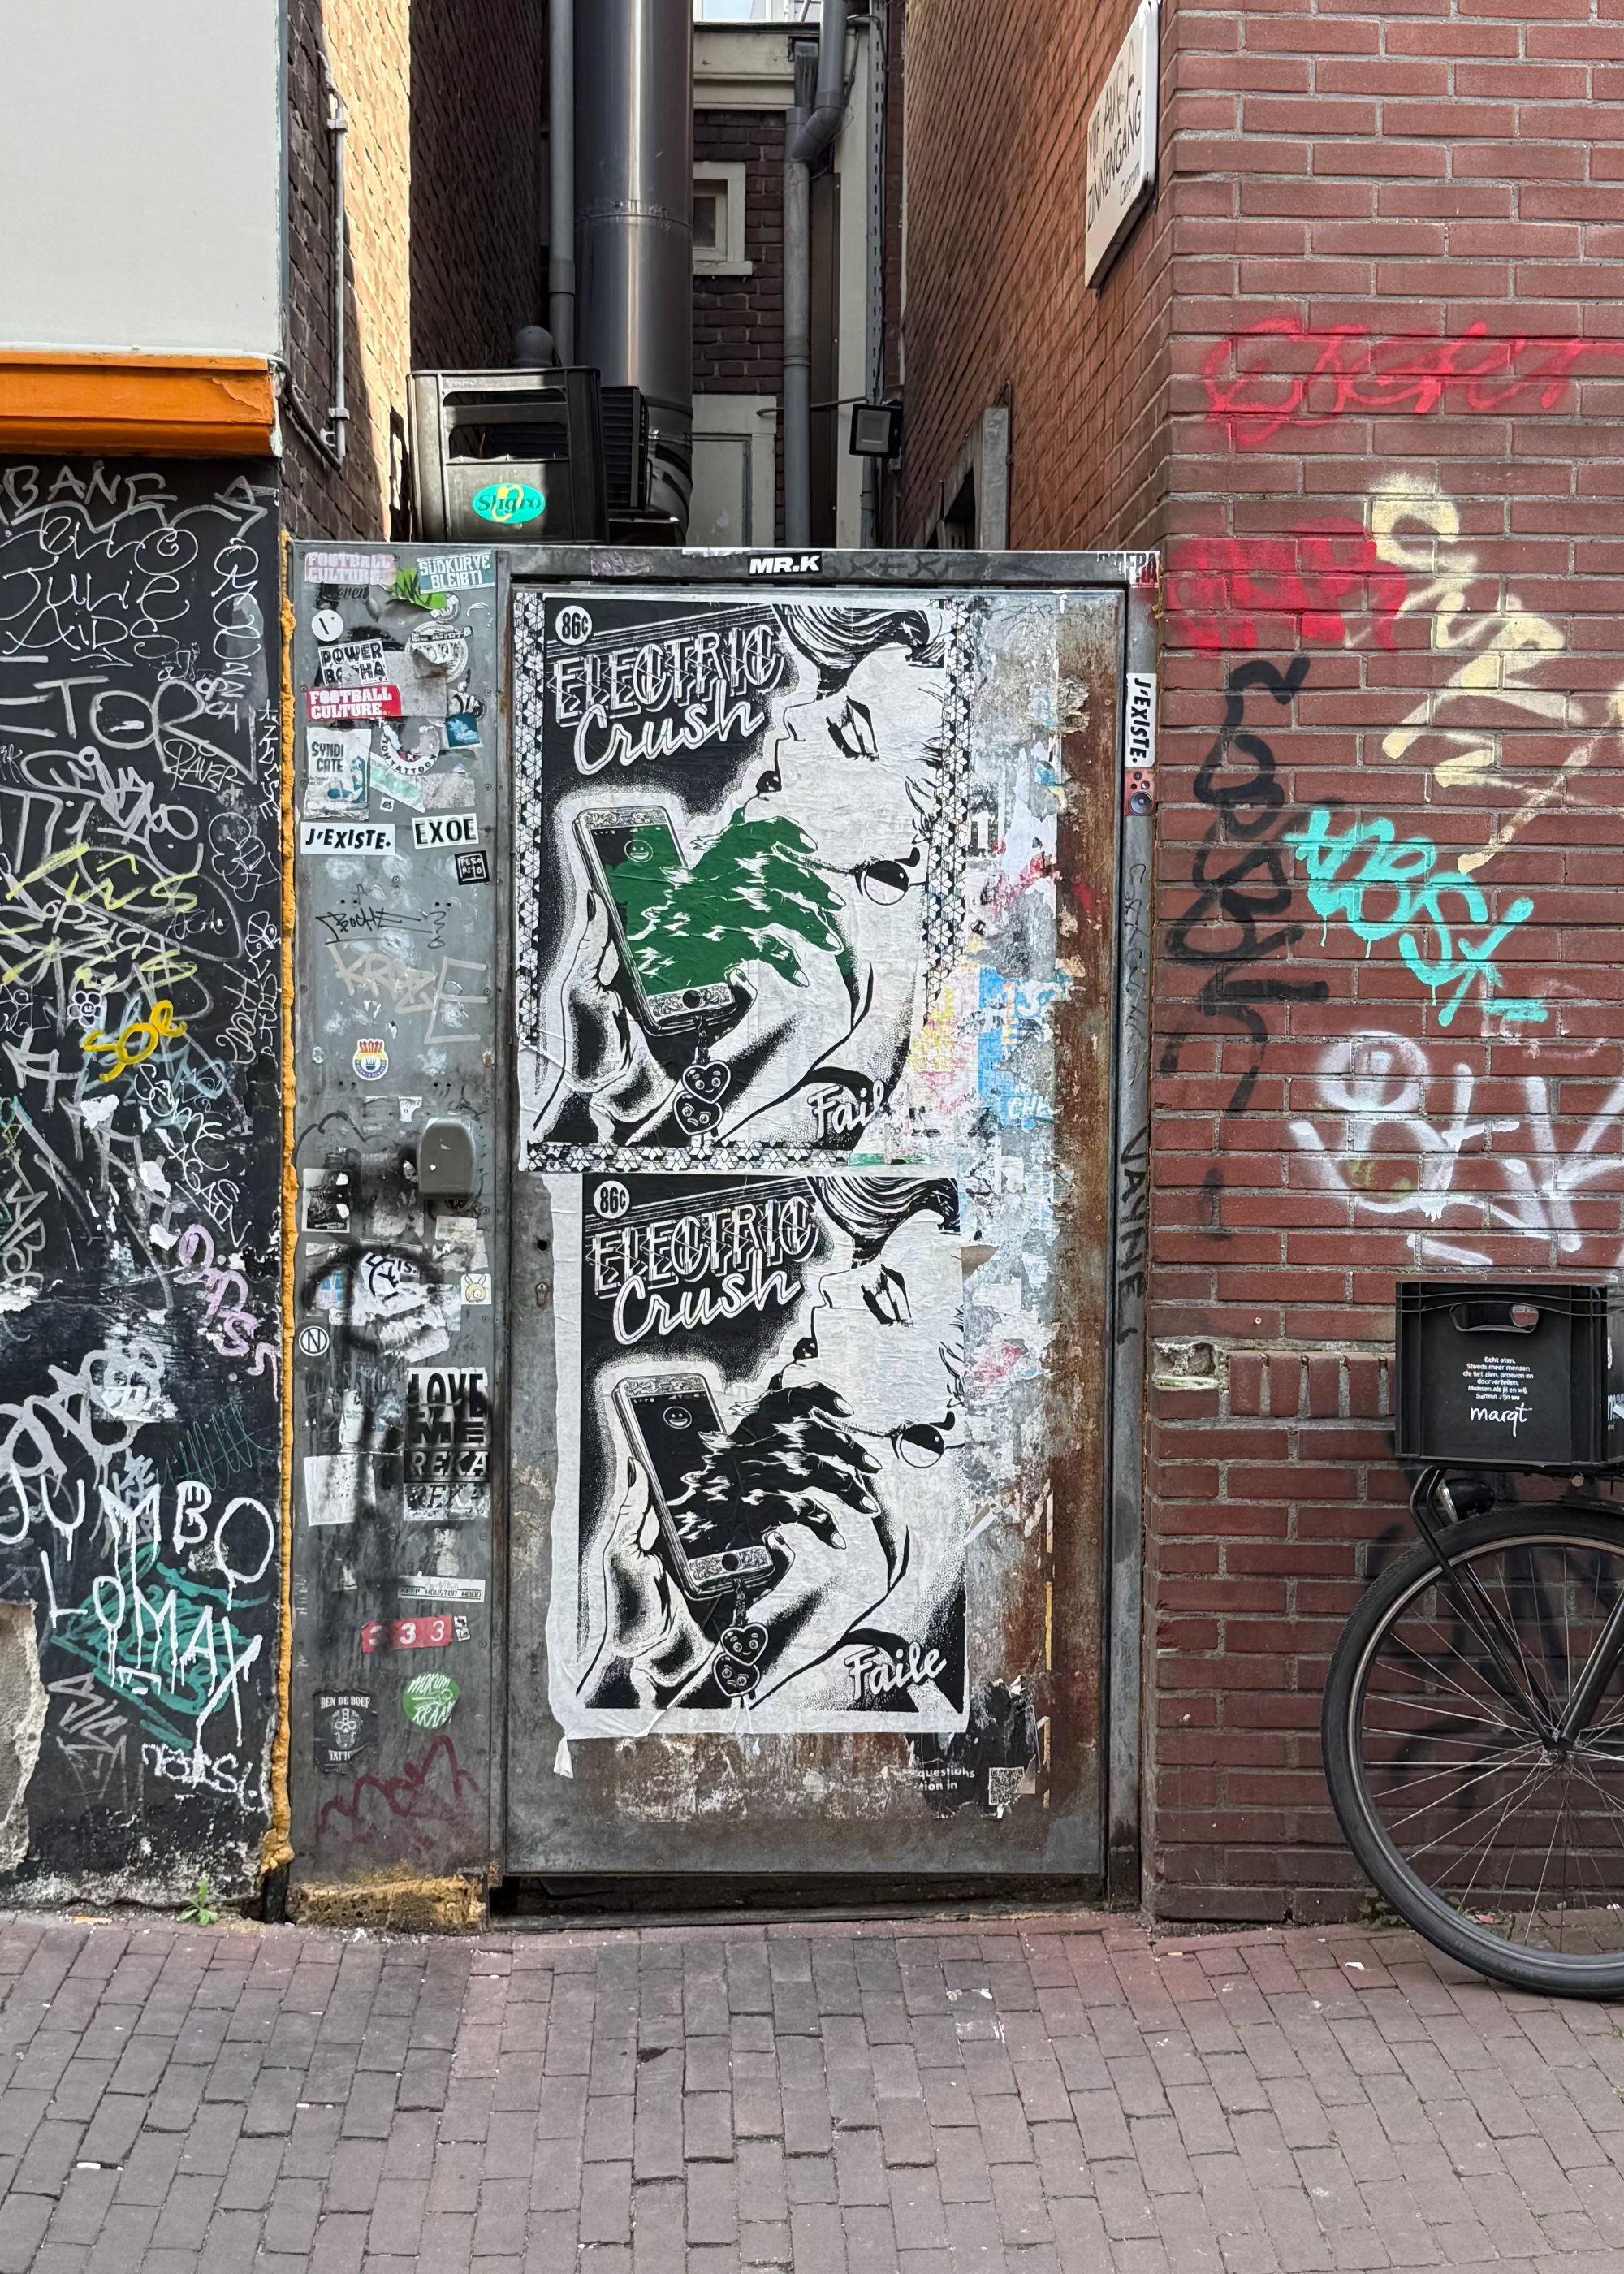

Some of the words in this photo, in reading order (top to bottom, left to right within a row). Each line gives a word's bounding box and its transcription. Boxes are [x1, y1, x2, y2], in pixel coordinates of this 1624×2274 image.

[419, 555, 490, 576] SÜDKURVE
[749, 555, 821, 574] MR.K
[431, 570, 483, 590] BLEIBT!
[561, 612, 589, 639] 86¢
[321, 642, 382, 668] POWER
[552, 625, 784, 727] ELECTRIC
[309, 687, 393, 704] FOOTBALL
[311, 703, 388, 720] CULTURE.
[574, 679, 765, 776] Crush
[305, 828, 391, 850] J'EXISTE.
[415, 819, 477, 845] EXOE
[599, 1187, 626, 1217] 86¢
[590, 1195, 818, 1299] ELECTRIC
[613, 1249, 801, 1345] Crush
[844, 1641, 947, 1701] Faile
[320, 1697, 336, 1710] BEN
[338, 1696, 349, 1706] DE
[918, 1766, 975, 1780] questions
[947, 1779, 958, 1790] in
